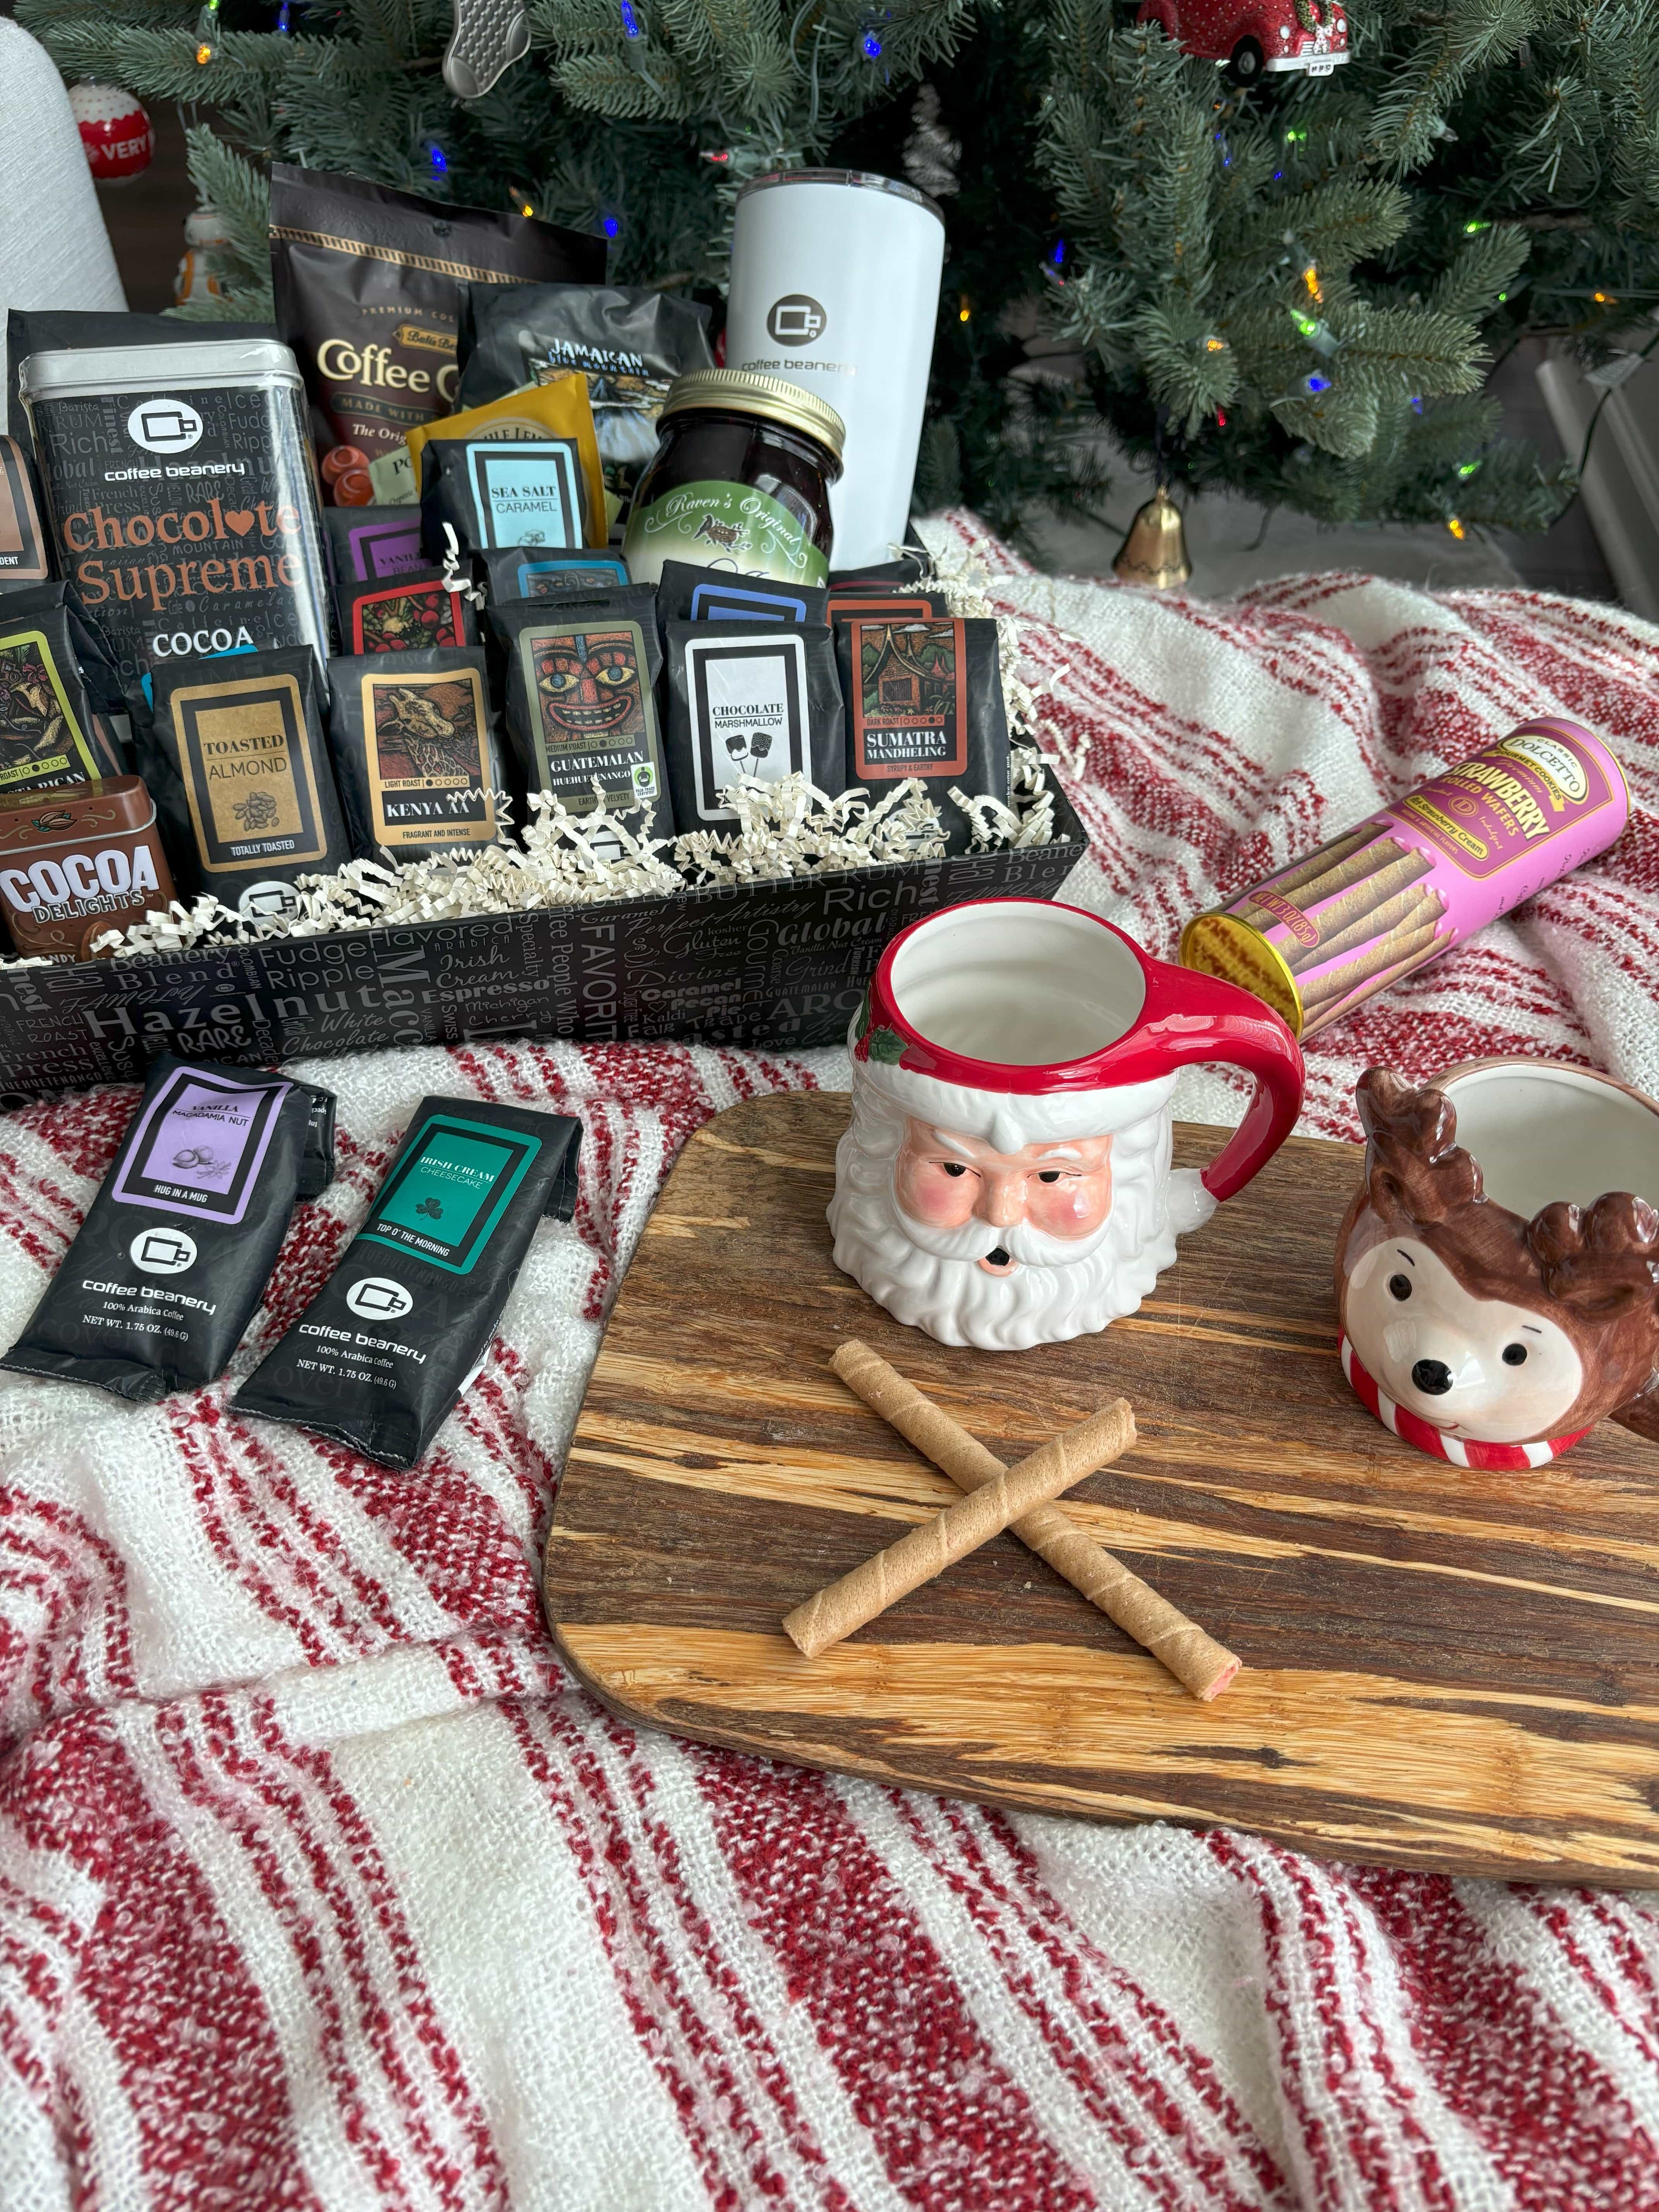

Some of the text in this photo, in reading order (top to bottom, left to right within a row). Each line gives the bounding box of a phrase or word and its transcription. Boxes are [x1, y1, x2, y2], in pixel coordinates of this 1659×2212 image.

[101, 134, 148, 160] VERY
[362, 306, 423, 316] PREMIUM
[548, 351, 650, 377] blue mountain
[551, 337, 643, 368] JAMAICAN
[317, 338, 431, 393] Coffee
[742, 359, 780, 372] coffee
[58, 400, 100, 414] Barista
[341, 397, 424, 421] MADE WITH
[53, 413, 103, 430] RUM
[101, 397, 124, 453] Finest
[217, 406, 230, 448] COLOMBIAN
[352, 423, 376, 437] The
[50, 430, 109, 457] Rich
[104, 463, 245, 481] coffee beanery
[91, 486, 139, 500] French
[185, 480, 225, 504] RARE
[491, 486, 556, 499] SEA SALT
[496, 502, 558, 514] CARAMEL
[665, 492, 802, 547] Raven's Original
[64, 499, 302, 550] Chocolte
[173, 539, 244, 555] MOUNTAIN
[393, 563, 423, 575] BEAN
[79, 553, 304, 611] Supreme
[153, 625, 254, 657] COCOA
[712, 703, 784, 716] CHOCOLATE
[714, 717, 783, 729] MARSHMALLOW
[204, 735, 285, 756] TOASTED
[546, 742, 586, 753] MEDIUM ROAST
[867, 731, 947, 747] SUMATRA
[550, 751, 644, 772] GUATEMALAN
[867, 746, 946, 759] MANDHELING
[1507, 738, 1580, 792] DOLCETTO
[1537, 738, 1577, 768] CLASSIC
[209, 757, 287, 780] ALMOND
[886, 764, 908, 773] SYRUPY
[1494, 750, 1561, 800] GOURMET COOKIES
[1496, 759, 1543, 793] Premium
[386, 799, 470, 817] KENYA AA
[607, 793, 630, 802] VELVETY
[1439, 777, 1519, 836] ROLLED WAFERS
[1443, 762, 1549, 841] STRAWBERRY
[402, 830, 432, 839] FRAGRANT
[447, 828, 471, 837] INTENSE
[1458, 832, 1484, 855] Cream
[231, 839, 295, 856] TOTALLY TOASTED
[0, 845, 160, 912] COCOA
[32, 889, 145, 924] DELIGHTS
[823, 880, 917, 915] Rich
[576, 903, 670, 924] Caramel
[625, 899, 816, 938] Perfect Artistry
[1251, 891, 1316, 943] NET WT 3 OZ (85g)
[369, 915, 513, 949] Flavored
[708, 924, 748, 936] kosher
[777, 911, 886, 946] Global
[258, 942, 367, 968] Fudge
[434, 935, 509, 951] ARABICA
[516, 913, 544, 977] Specialty
[663, 930, 742, 959] Gluten
[694, 947, 741, 961] Free
[790, 936, 883, 955] Vanilla Nut Cream
[110, 946, 232, 972] Beanery
[440, 945, 510, 972] Irish
[742, 920, 780, 1008] GOURMET
[771, 949, 788, 984] Coarse
[785, 950, 852, 986] Grind
[851, 947, 865, 975] TURKISH
[113, 962, 237, 990] Blend
[266, 962, 374, 991] Ripple
[436, 970, 520, 989] Cream
[547, 942, 580, 1034] People Who
[627, 967, 738, 988] Divine
[421, 979, 550, 1004] Espresso
[83, 985, 381, 1038] Hazelnut
[465, 997, 549, 1012] Michigan
[642, 1008, 686, 1024] Kaldi
[16, 1013, 84, 1032] FRENCH
[321, 1012, 386, 1033] White
[422, 1007, 437, 1041] VANILLA
[442, 1005, 458, 1040] SWISS
[27, 1029, 88, 1044] ROAST
[177, 1025, 251, 1053] RARE
[282, 1028, 389, 1056] Chocolate
[0, 1044, 88, 1063] French
[4, 1058, 94, 1078] Press
[173, 1109, 249, 1127] MACADAMIA NUT
[420, 1156, 495, 1183] IRISH CREAM
[420, 1166, 483, 1190] CHEESECAKE
[155, 1185, 208, 1203] HUG IN A MUG
[376, 1223, 391, 1233] TOP
[400, 1230, 417, 1243] THE
[414, 1235, 450, 1257] MORNING
[82, 1279, 216, 1316] coffee beanery
[103, 1301, 184, 1321] 100% Arabica Coffee
[82, 1315, 189, 1342] NET WT. 1.75 OZ. (49.6 G)
[489, 1319, 499, 1340] make
[299, 1324, 427, 1365] coffee beanery
[316, 1345, 394, 1369] 100% Arabica Coffee
[296, 1358, 397, 1390] NET WT. 1.75 OZ. (49.6 G)
